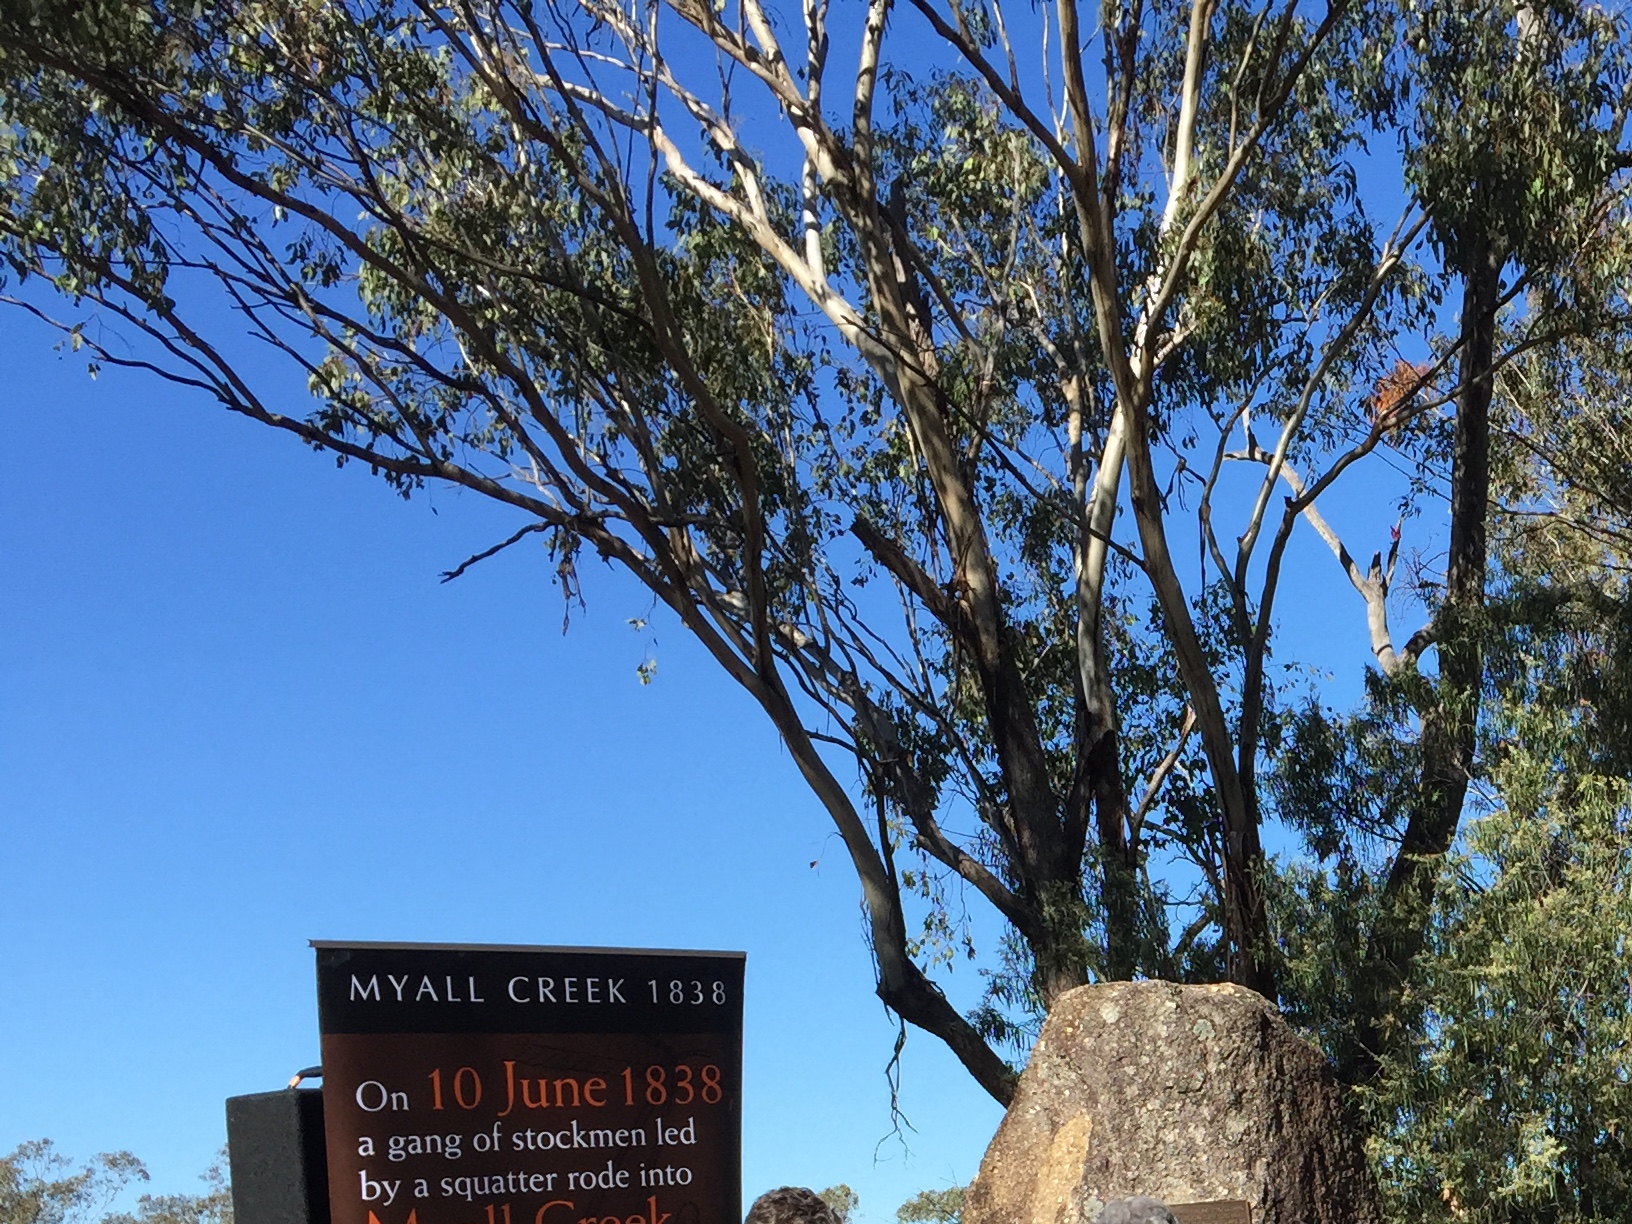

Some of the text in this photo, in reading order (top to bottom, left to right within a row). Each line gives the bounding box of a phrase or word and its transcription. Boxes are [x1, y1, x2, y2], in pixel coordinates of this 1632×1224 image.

[350, 974, 726, 1005] MYALL CREEK 1838
[356, 1061, 722, 1117] On 10 June 1838
[358, 1117, 697, 1161] a gang of stockmen led
[359, 1161, 692, 1206] by a squatter rode into
